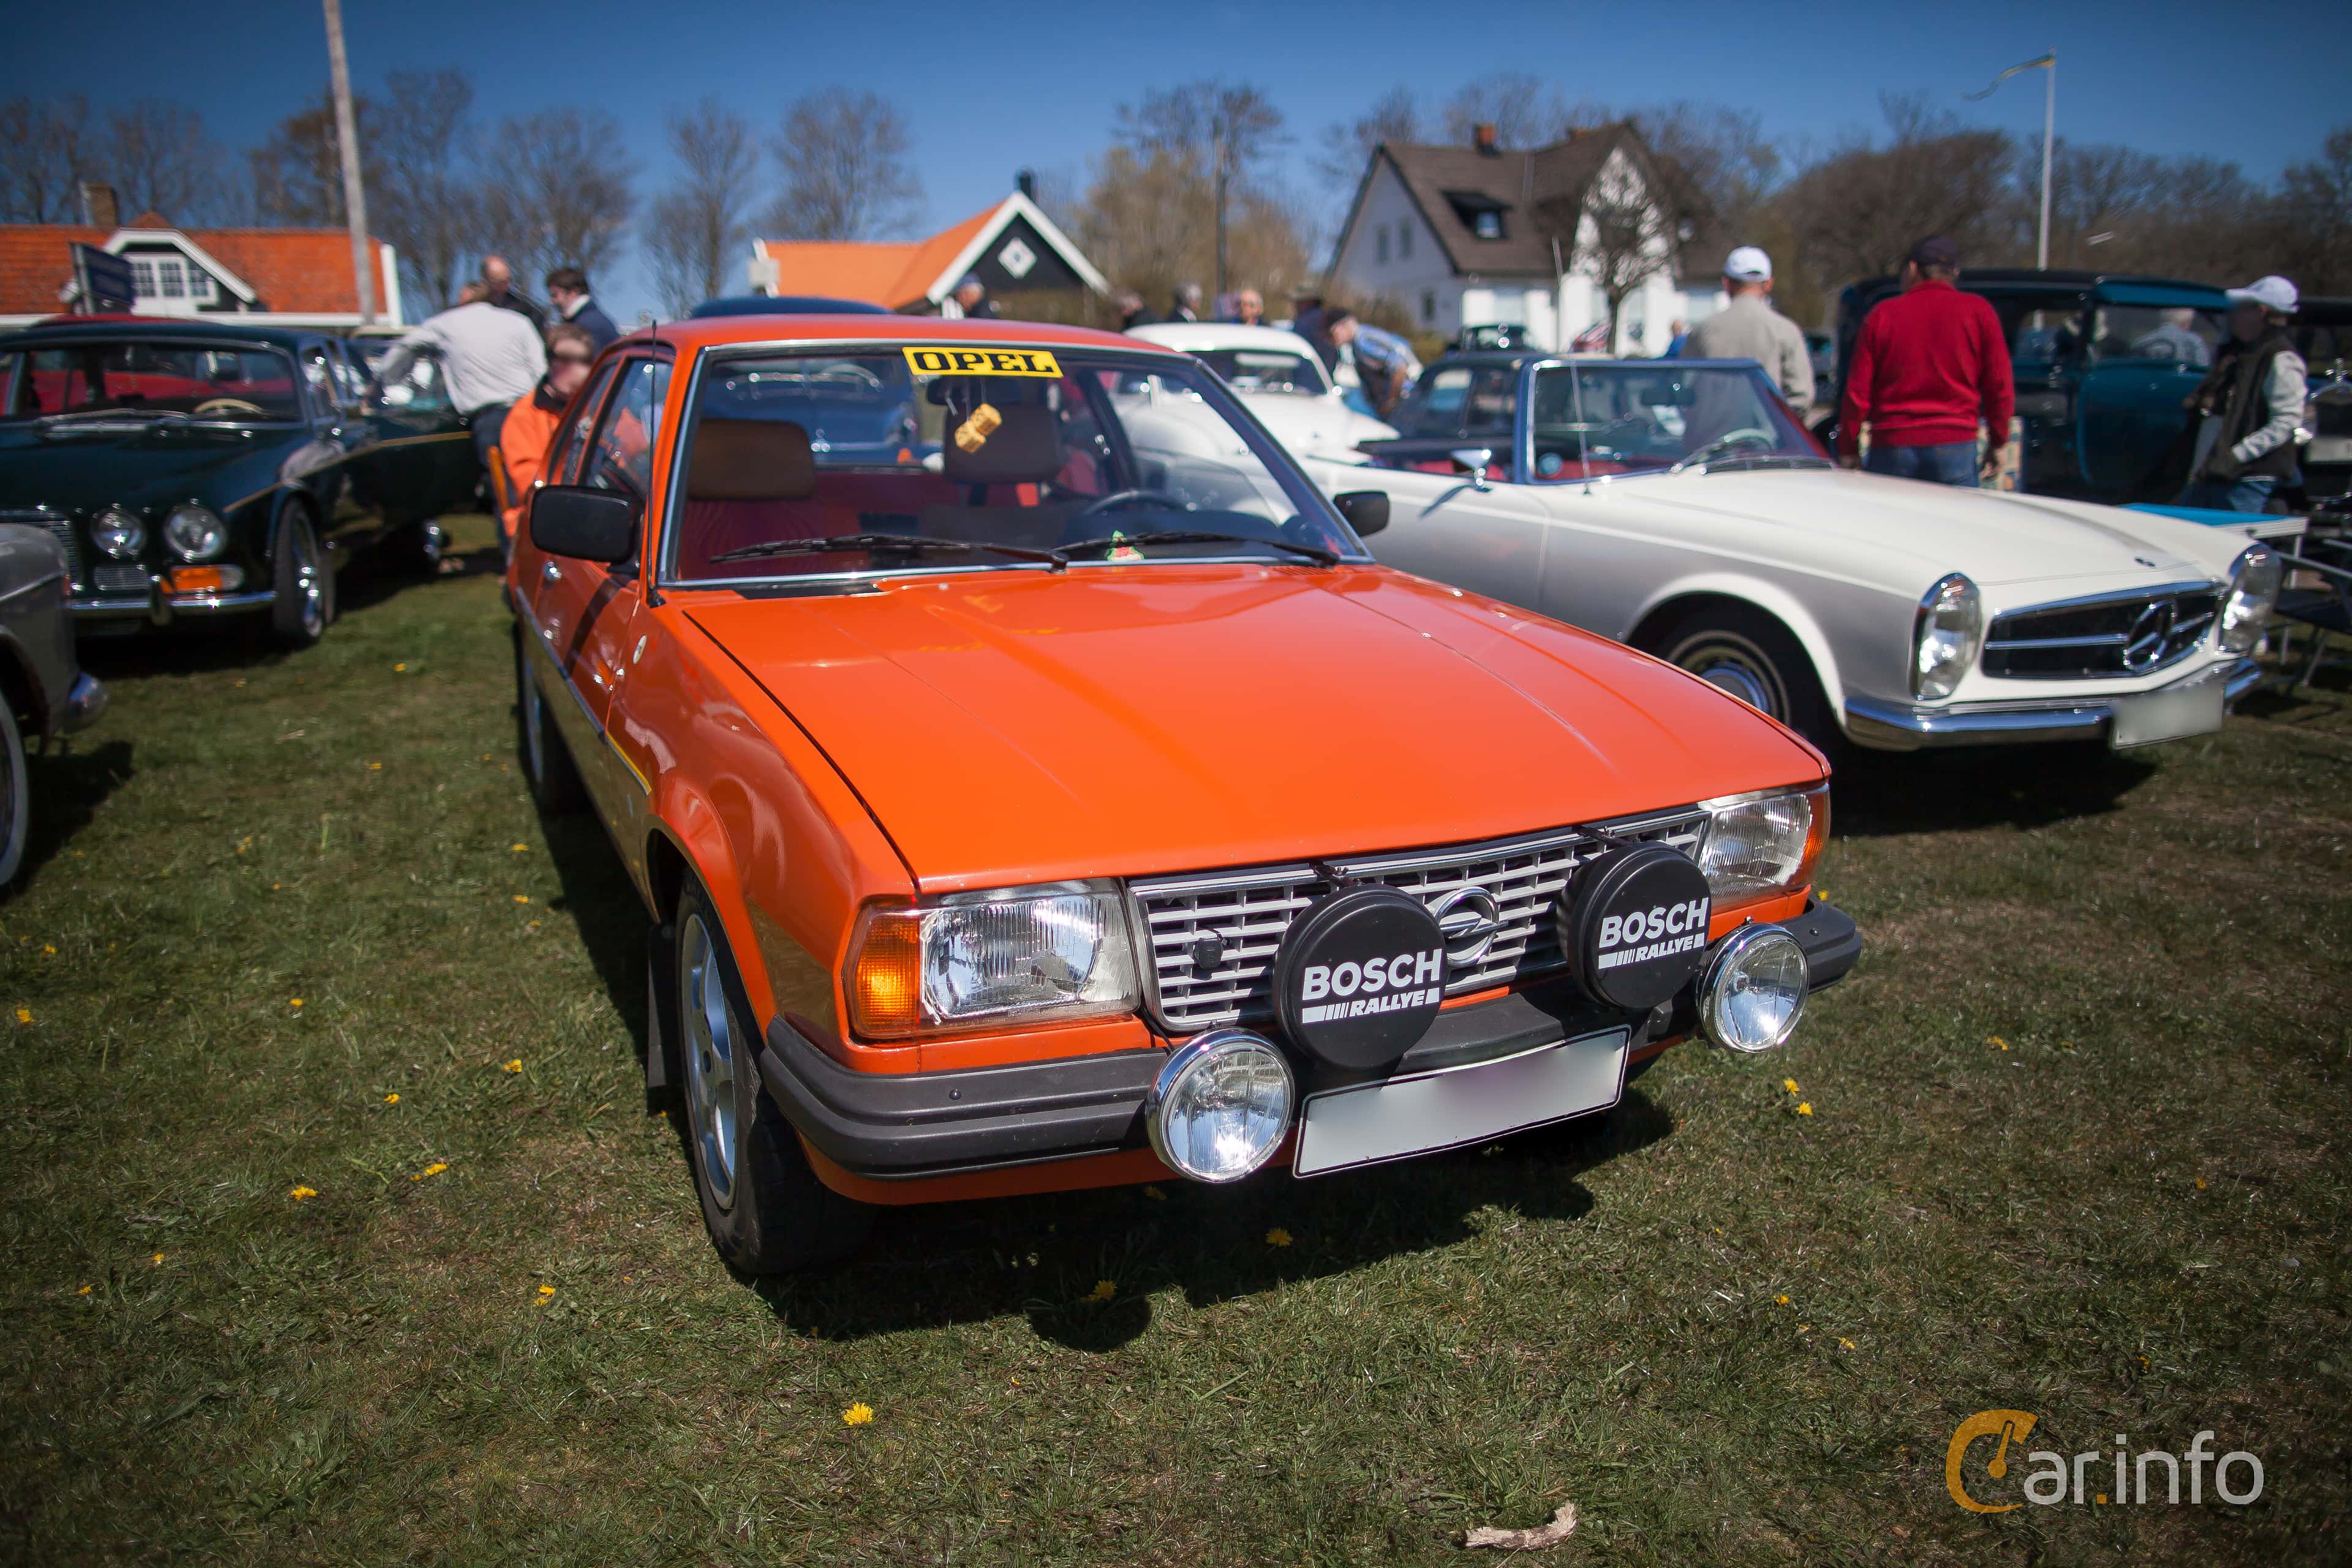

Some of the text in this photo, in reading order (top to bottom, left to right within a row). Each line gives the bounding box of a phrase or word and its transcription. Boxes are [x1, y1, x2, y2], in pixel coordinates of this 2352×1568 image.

[913, 352, 1054, 372] OPEL
[1599, 897, 1709, 949] BOSCH
[1635, 935, 1694, 962] RALLYE
[1302, 948, 1442, 1001] BOSCH
[1349, 989, 1426, 1017] RALLYE
